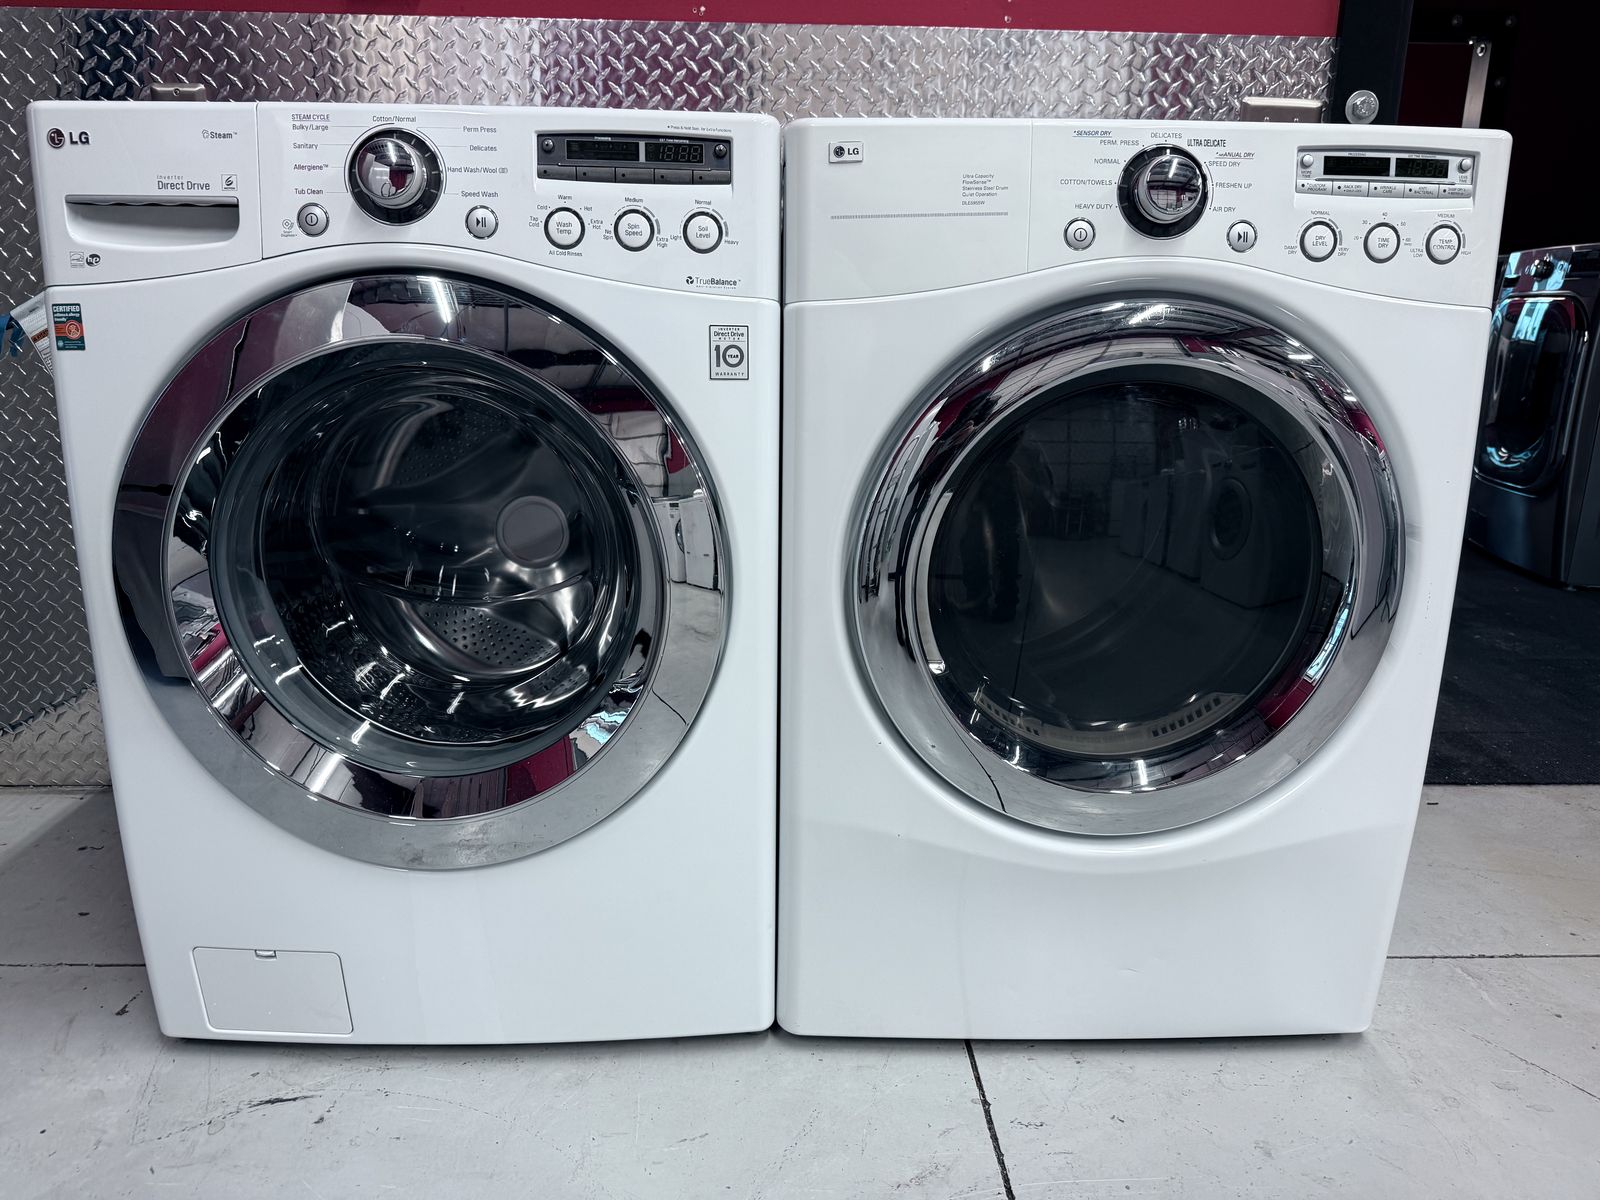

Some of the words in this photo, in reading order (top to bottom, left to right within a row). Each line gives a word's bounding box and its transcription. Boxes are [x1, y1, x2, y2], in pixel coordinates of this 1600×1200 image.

[292, 124, 329, 132] Bulky/Large
[69, 131, 90, 145] LG
[293, 142, 319, 150] Sanitary
[1187, 139, 1203, 147] ULTRA
[1203, 139, 1226, 148] DELICATE
[158, 180, 184, 190] Direct
[187, 181, 210, 190] Drive
[624, 196, 644, 204] Medium
[556, 227, 572, 235] Temp
[627, 223, 640, 231] Spin
[624, 229, 642, 237] Speed
[53, 305, 80, 313] CERTIFIED
[714, 344, 744, 368] 10
